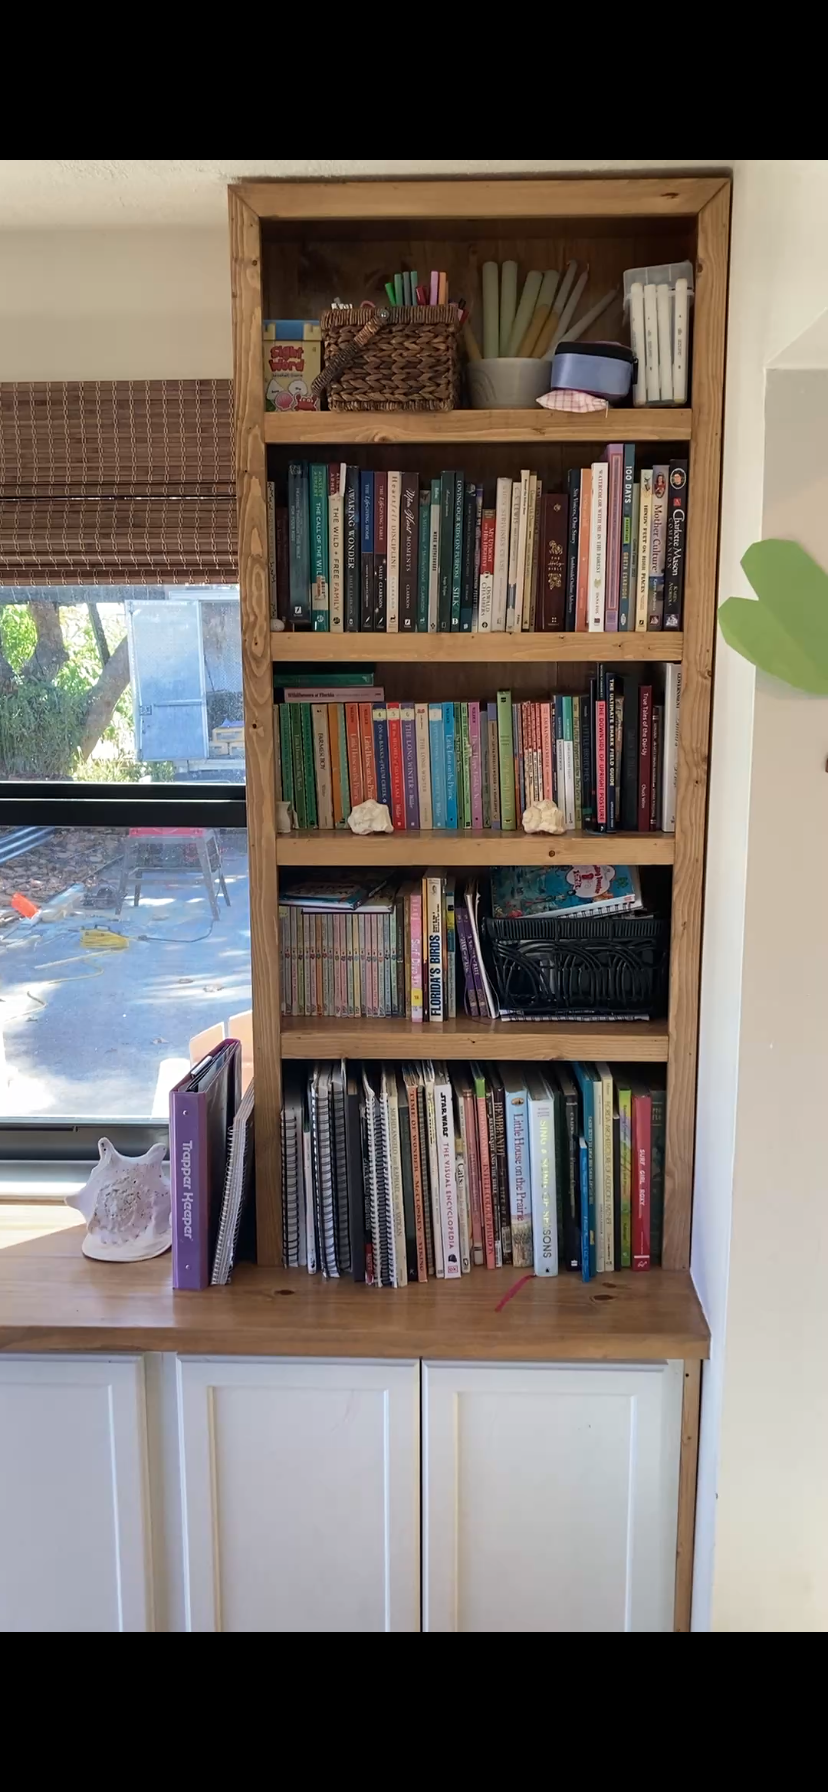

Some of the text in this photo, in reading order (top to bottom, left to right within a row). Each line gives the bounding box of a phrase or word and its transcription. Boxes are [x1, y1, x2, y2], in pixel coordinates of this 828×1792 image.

[625, 466, 633, 482] 100
[624, 484, 632, 505] DAYS
[347, 487, 356, 570] AWAKING WONDER
[652, 504, 663, 571] Mother Culture
[672, 508, 686, 577] Charlotte Mason
[390, 526, 398, 570] DISCIPLINE
[452, 587, 460, 607] SILK
[480, 582, 488, 617] CHAMBERS
[485, 586, 493, 613] OSWALD
[364, 735, 372, 750] Little
[377, 724, 384, 734] ON
[445, 735, 453, 750] Little
[317, 733, 326, 757] FARMER
[365, 750, 373, 768] House
[411, 938, 421, 957] Surf
[429, 934, 441, 964] BIRDS
[429, 967, 441, 1017] FLORIDA'S
[409, 1091, 417, 1118] TIME
[390, 1107, 399, 1155] MICHELANGELO
[494, 1101, 505, 1157] REMBRANDT
[539, 1119, 548, 1145] SING
[393, 1166, 401, 1194] RAPHAEL
[440, 1091, 455, 1250] STAR WARS THE VISUAL ENCYCLOPEDIA
[513, 1113, 528, 1222] Little House on the Prairie
[605, 1165, 612, 1174] OF
[181, 1139, 194, 1239] Trapper Keeper
[542, 1209, 552, 1259] SEASONS
